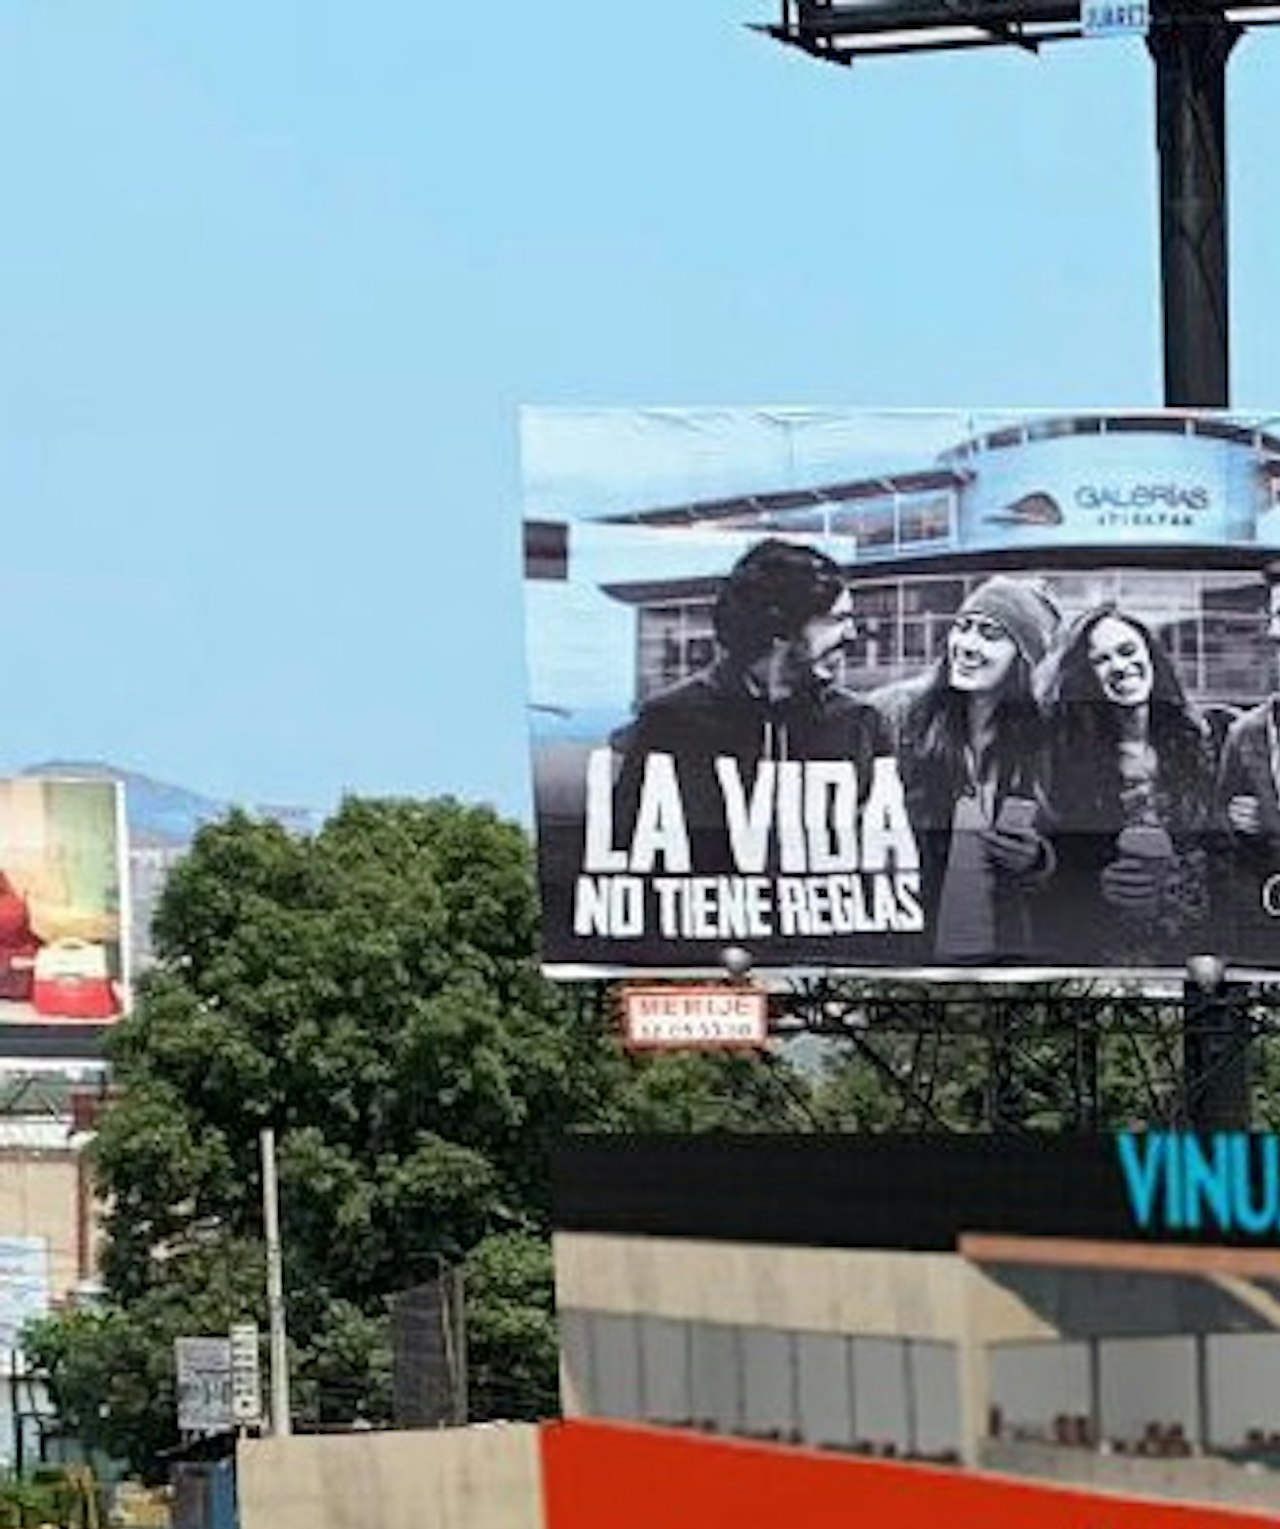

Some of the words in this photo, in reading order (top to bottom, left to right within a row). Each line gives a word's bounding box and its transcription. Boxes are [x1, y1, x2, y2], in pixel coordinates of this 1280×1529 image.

[584, 746, 692, 874] LA
[714, 756, 920, 874] VIDA
[573, 874, 645, 938] NO
[652, 875, 773, 940] TIENE
[775, 871, 924, 937] REGLAS
